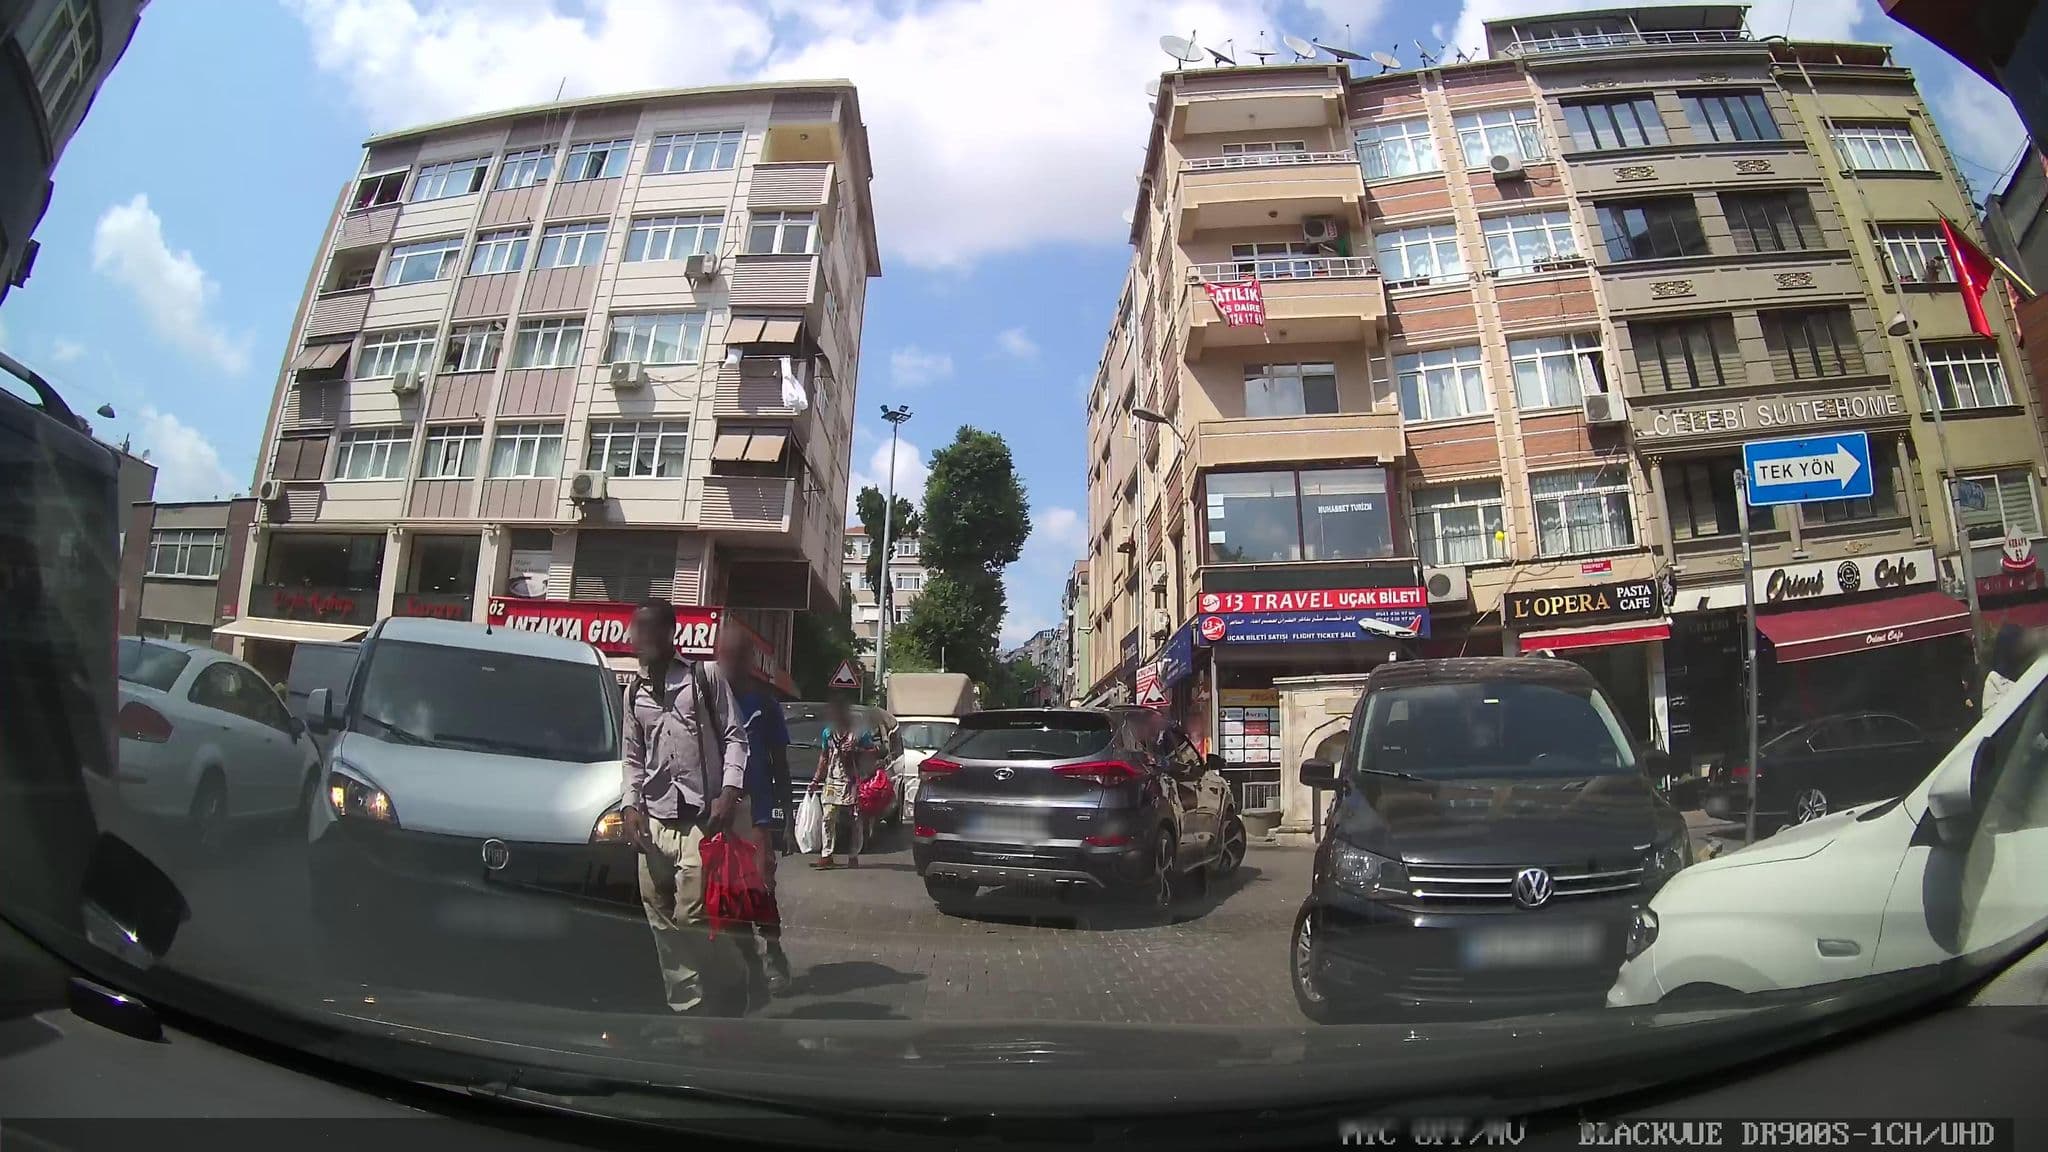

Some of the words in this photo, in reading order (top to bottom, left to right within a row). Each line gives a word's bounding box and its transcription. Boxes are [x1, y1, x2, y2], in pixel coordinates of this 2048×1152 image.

[1209, 286, 1260, 303] ATILIK
[1836, 394, 1900, 419] HOME
[1759, 462, 1793, 481] TEK
[1798, 457, 1836, 478] YÖN
[489, 601, 505, 616] ÖZ
[1225, 595, 1244, 611] 13
[1252, 592, 1333, 610] TRAVEL
[1339, 591, 1376, 608] UÇAK
[1379, 588, 1420, 604] BİLETİ
[1513, 592, 1611, 619] L'OPERA
[1616, 584, 1652, 598] PASTA
[1619, 596, 1651, 610] CAFE
[588, 619, 633, 644] GIDA
[1227, 634, 1245, 642] UÇAK
[1246, 632, 1267, 641] BİLETİ
[1268, 632, 1289, 643] SATIŞI
[1292, 632, 1316, 640] FLIGHT
[1316, 631, 1340, 639] TICKET
[1340, 630, 1357, 638] SALE
